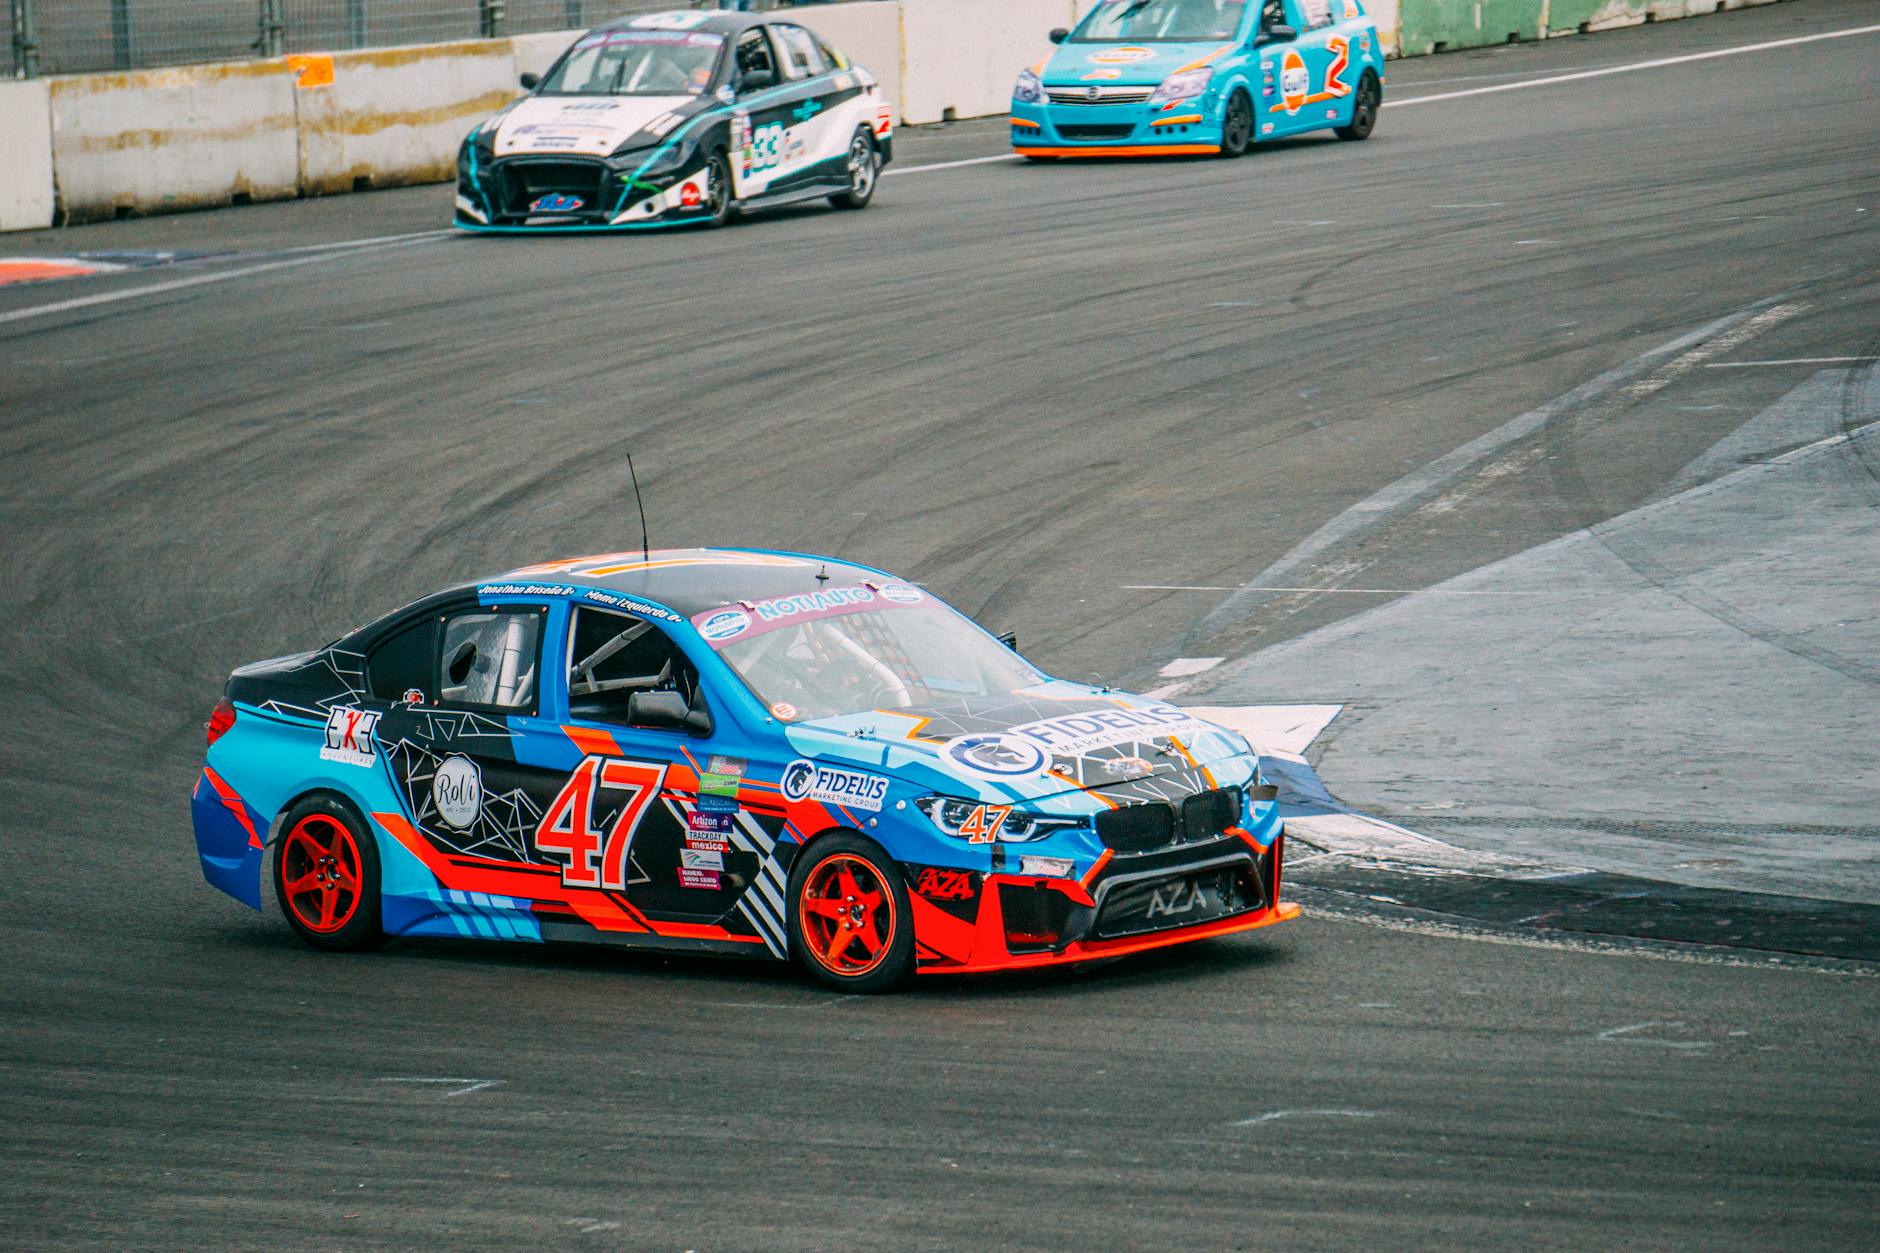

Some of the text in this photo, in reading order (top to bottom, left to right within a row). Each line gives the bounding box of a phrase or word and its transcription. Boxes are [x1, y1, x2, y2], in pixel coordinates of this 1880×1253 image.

[1325, 33, 1352, 97] 2
[752, 122, 784, 172] 33
[478, 584, 523, 594] Jonathan
[584, 589, 615, 605] Memo
[616, 596, 669, 619] Izquierdo
[756, 587, 875, 622] NOTIAUTO
[1018, 706, 1192, 745] FIDELIS
[812, 790, 881, 809] MARKETING GROUP
[815, 770, 886, 799] FIDELIS
[534, 754, 669, 891] 47
[690, 831, 722, 841] TRACKDAY
[692, 814, 718, 827] Artizon
[958, 804, 1013, 845] 47
[691, 841, 724, 851] mexico
[917, 867, 975, 900] AZA
[1146, 876, 1208, 919] AZA
